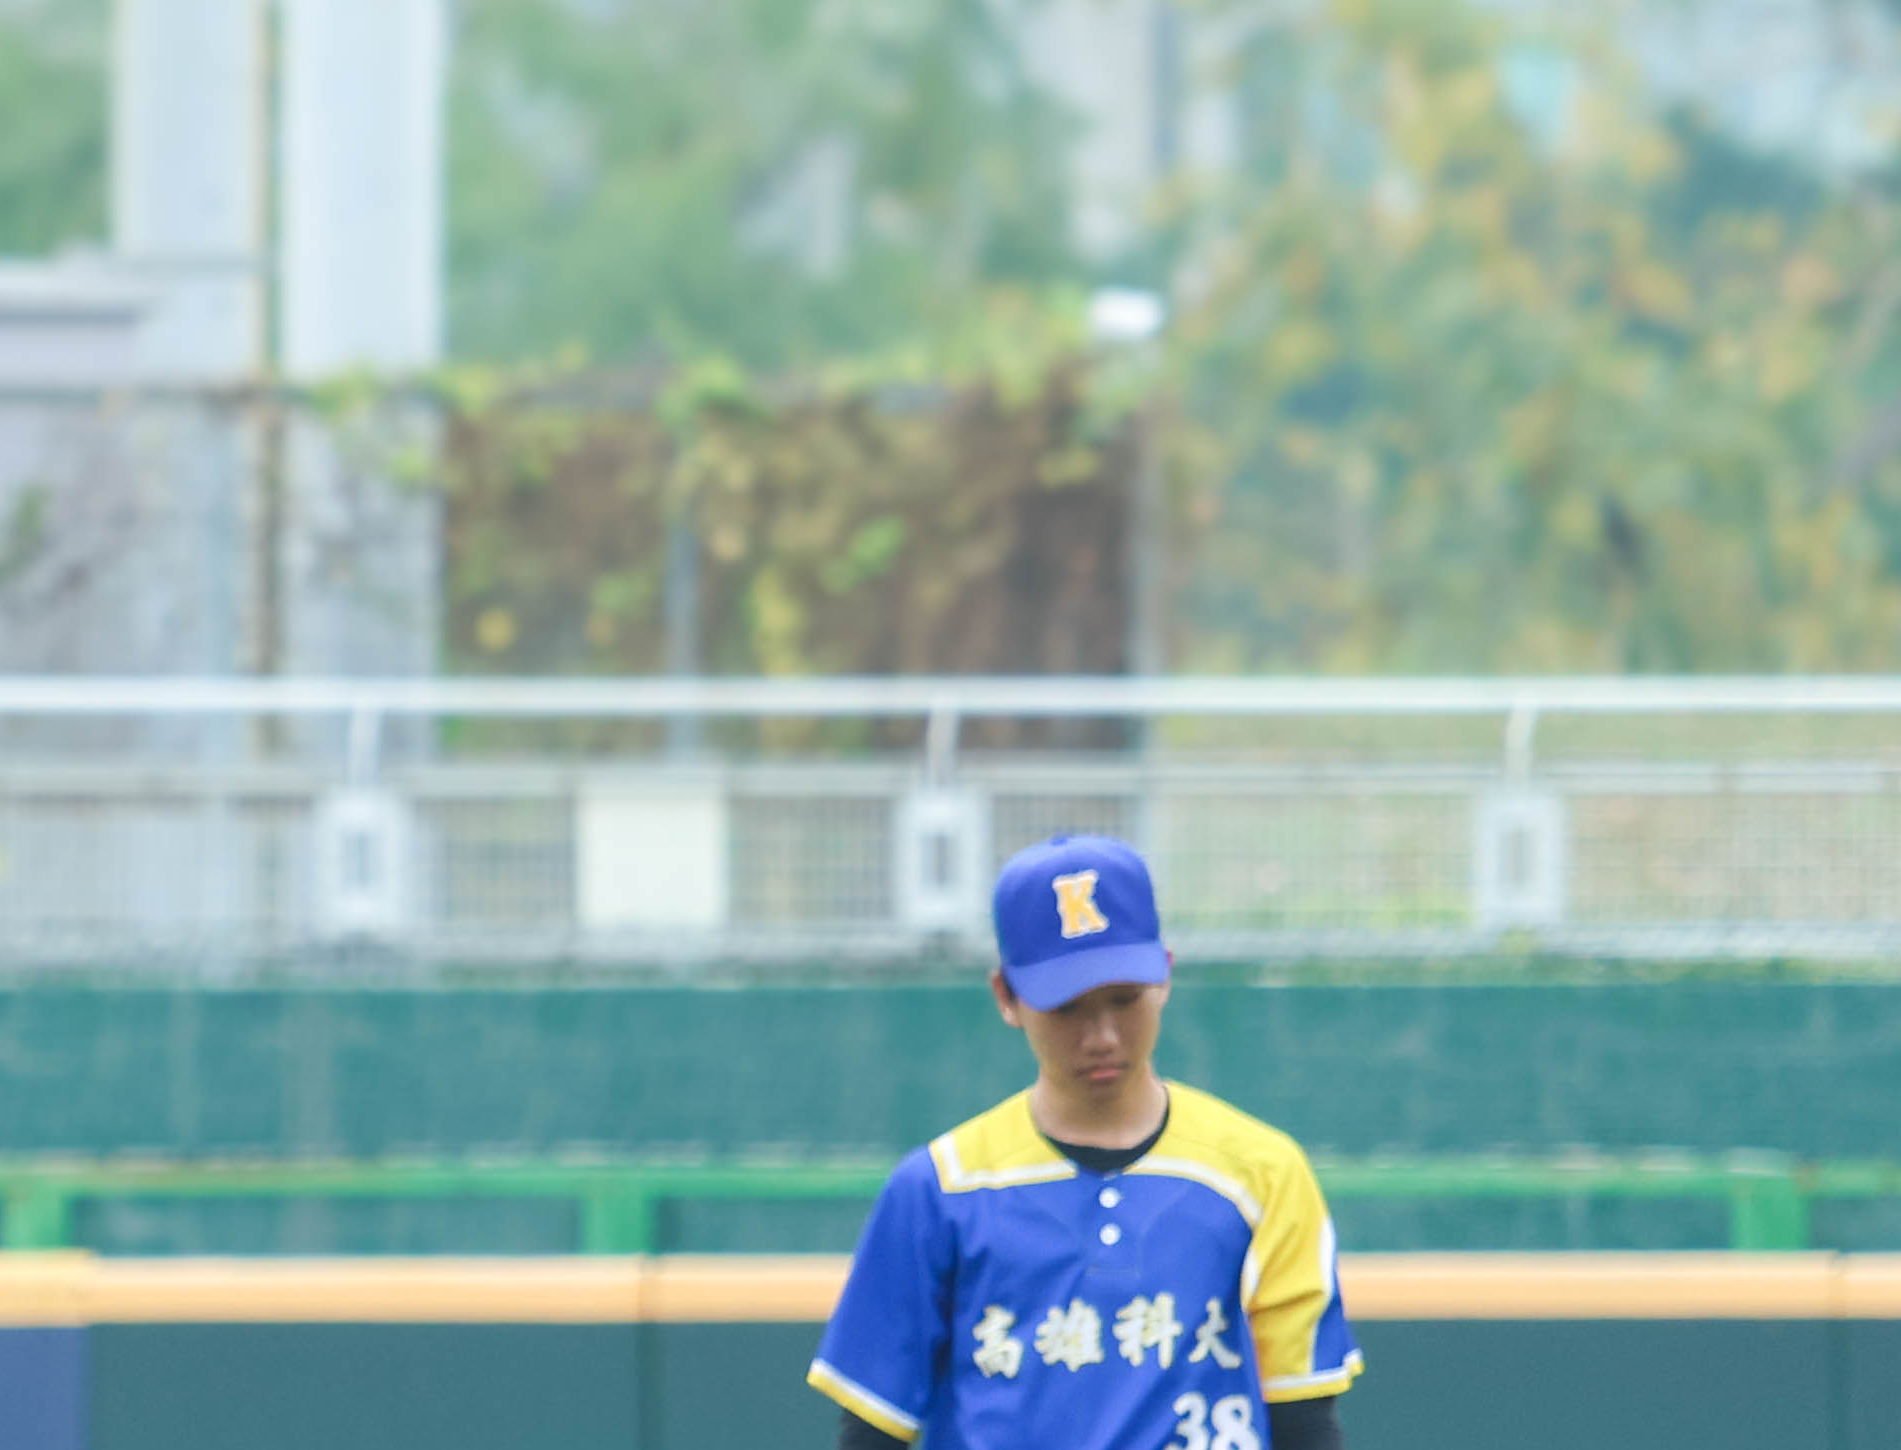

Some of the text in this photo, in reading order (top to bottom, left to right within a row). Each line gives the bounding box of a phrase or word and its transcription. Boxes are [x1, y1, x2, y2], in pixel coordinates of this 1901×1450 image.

[1052, 869, 1110, 939] K
[972, 1291, 1242, 1379] 高雄科大
